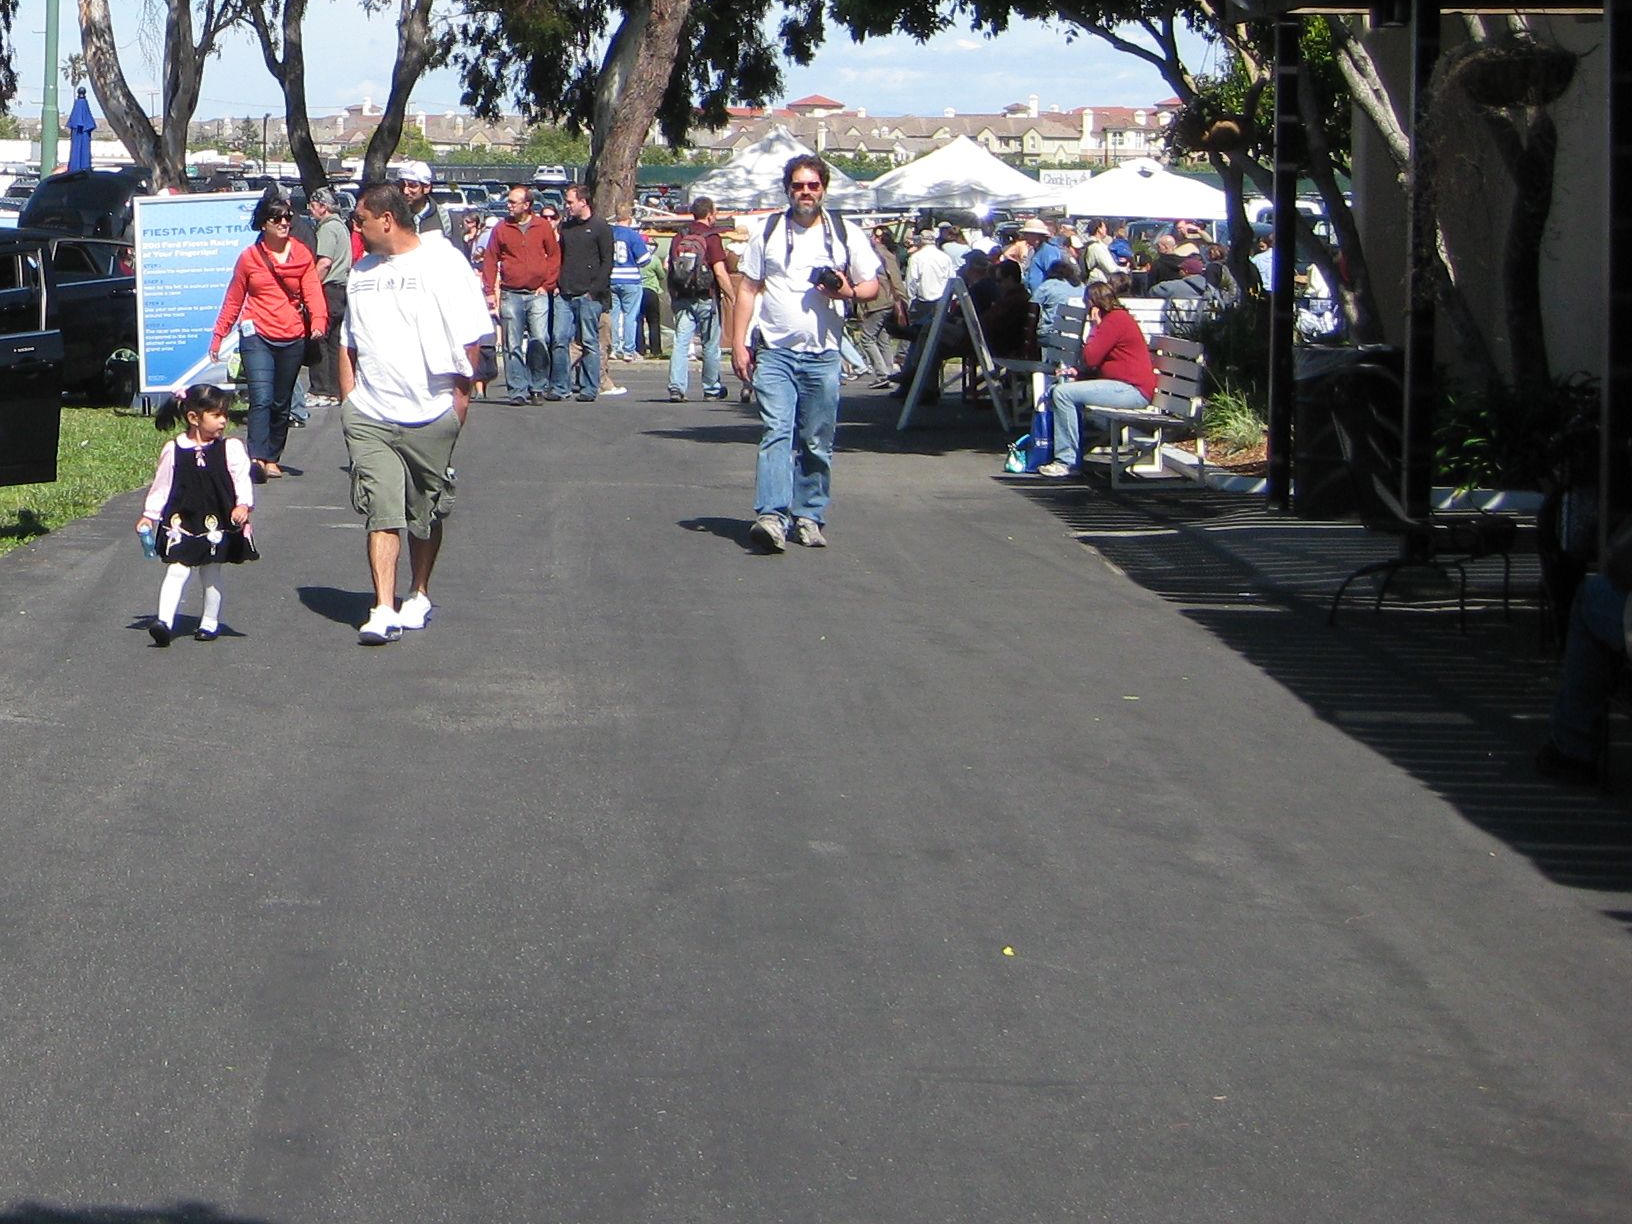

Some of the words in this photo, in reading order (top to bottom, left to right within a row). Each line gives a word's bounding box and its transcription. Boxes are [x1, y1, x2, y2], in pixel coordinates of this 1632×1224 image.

[143, 227, 186, 236] FIESTA
[190, 226, 220, 235] FAST
[225, 224, 252, 233] TRA
[209, 239, 239, 248] Racing
